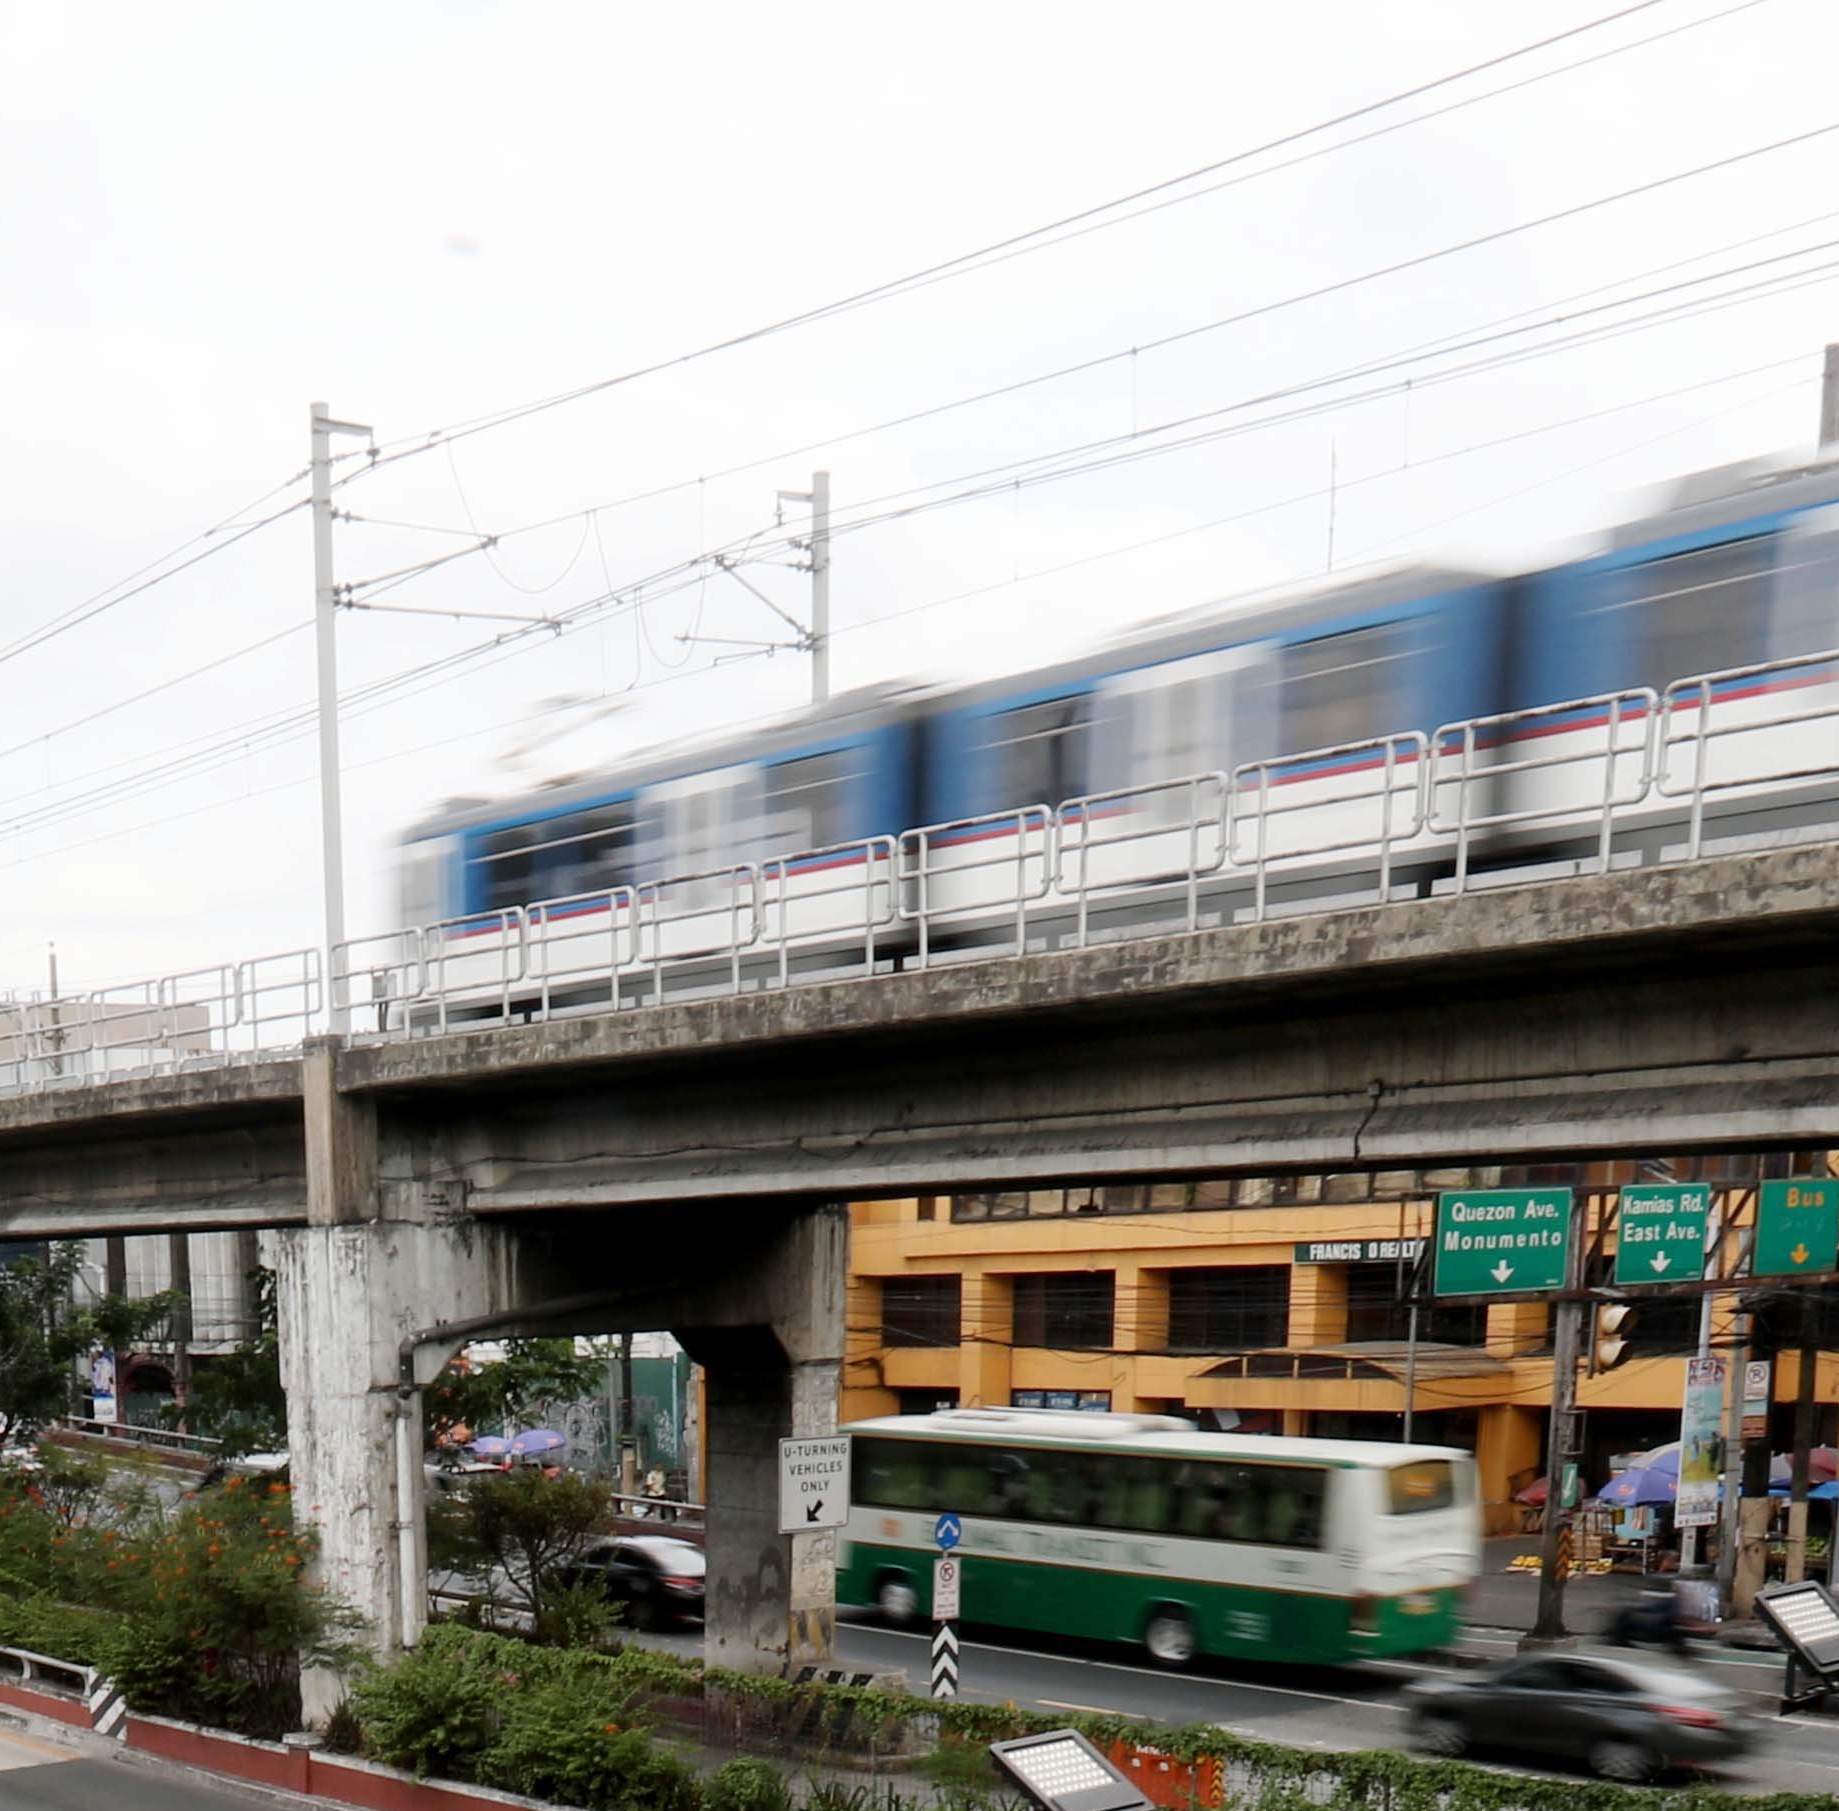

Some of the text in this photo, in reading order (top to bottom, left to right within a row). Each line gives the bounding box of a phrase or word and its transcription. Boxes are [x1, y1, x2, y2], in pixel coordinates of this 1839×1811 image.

[1623, 1193, 1704, 1215] Kamias Rd.
[1786, 1187, 1824, 1208] Bus
[1451, 1199, 1559, 1222] Quezon Ave.
[1444, 1229, 1562, 1251] Monumento
[1623, 1221, 1701, 1242] East Ave.
[1310, 1243, 1361, 1260] FRANCIS
[784, 1443, 847, 1458] U-TURNING
[789, 1460, 843, 1476] VEHICLES
[801, 1480, 830, 1493] ONLY
